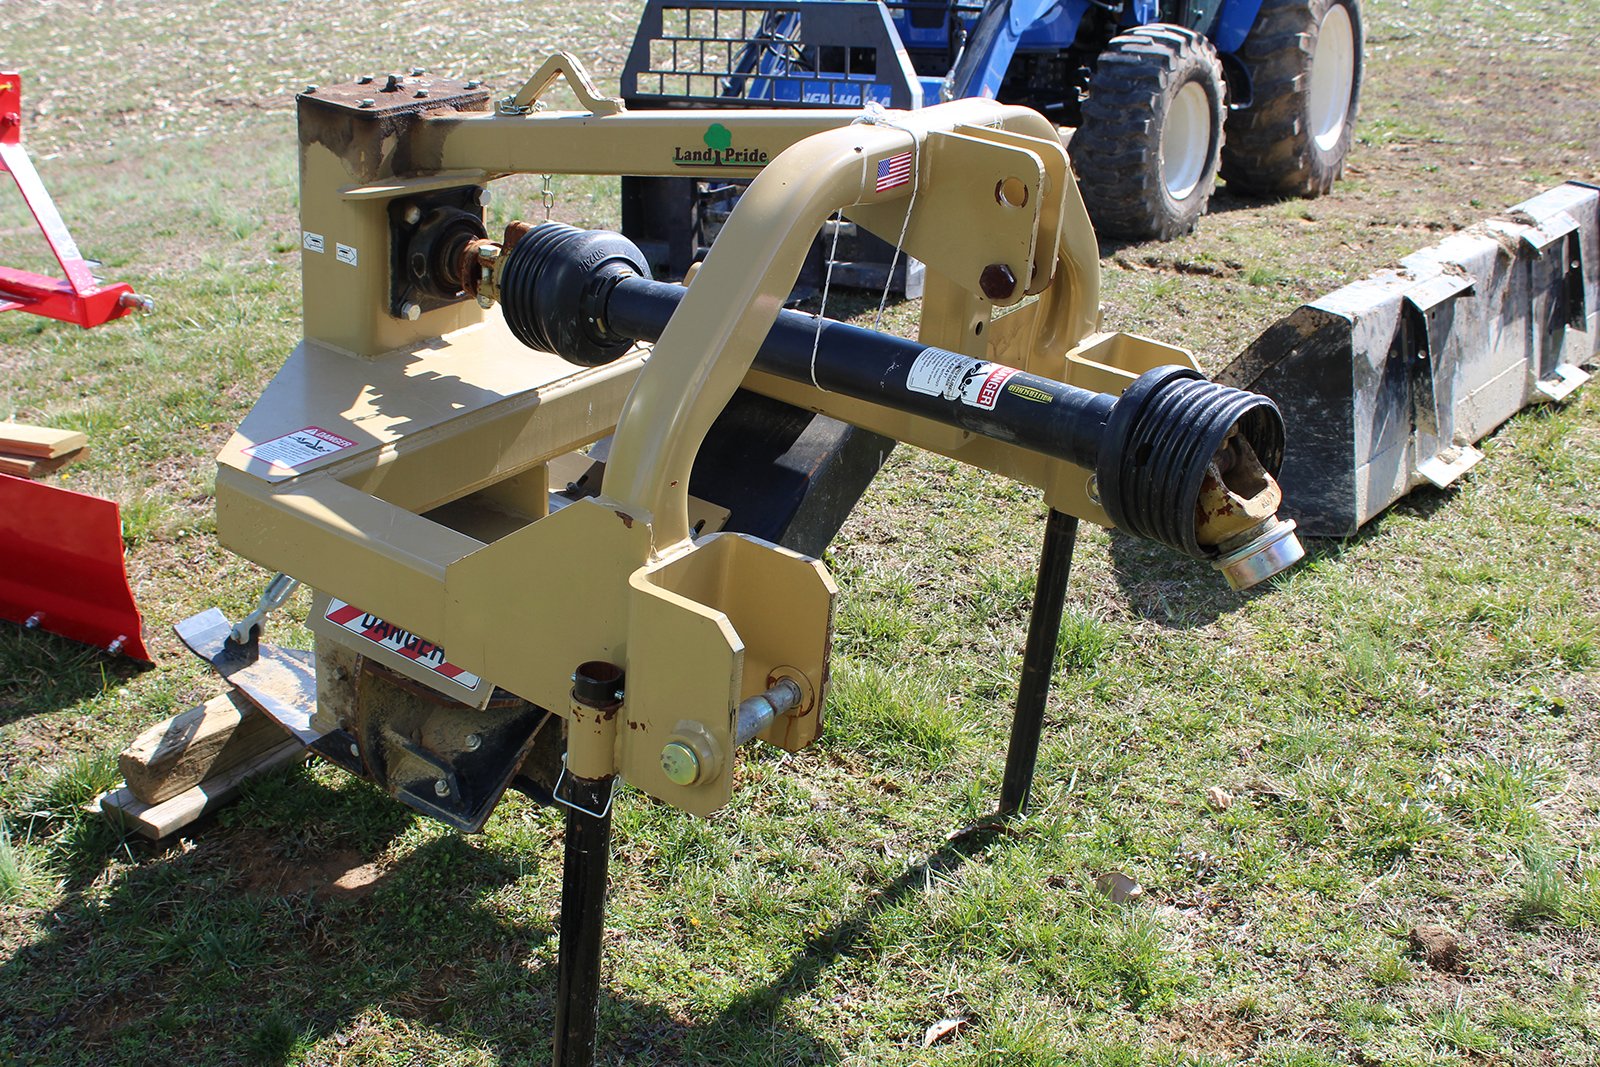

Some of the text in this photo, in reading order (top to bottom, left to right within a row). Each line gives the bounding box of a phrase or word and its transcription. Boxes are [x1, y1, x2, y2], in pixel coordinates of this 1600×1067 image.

[675, 147, 768, 162] Land Pride
[980, 367, 1018, 406] DANGER
[1008, 384, 1053, 403] WALTERSCHEID
[316, 431, 352, 447] DANGER
[361, 612, 446, 665] DANGER
